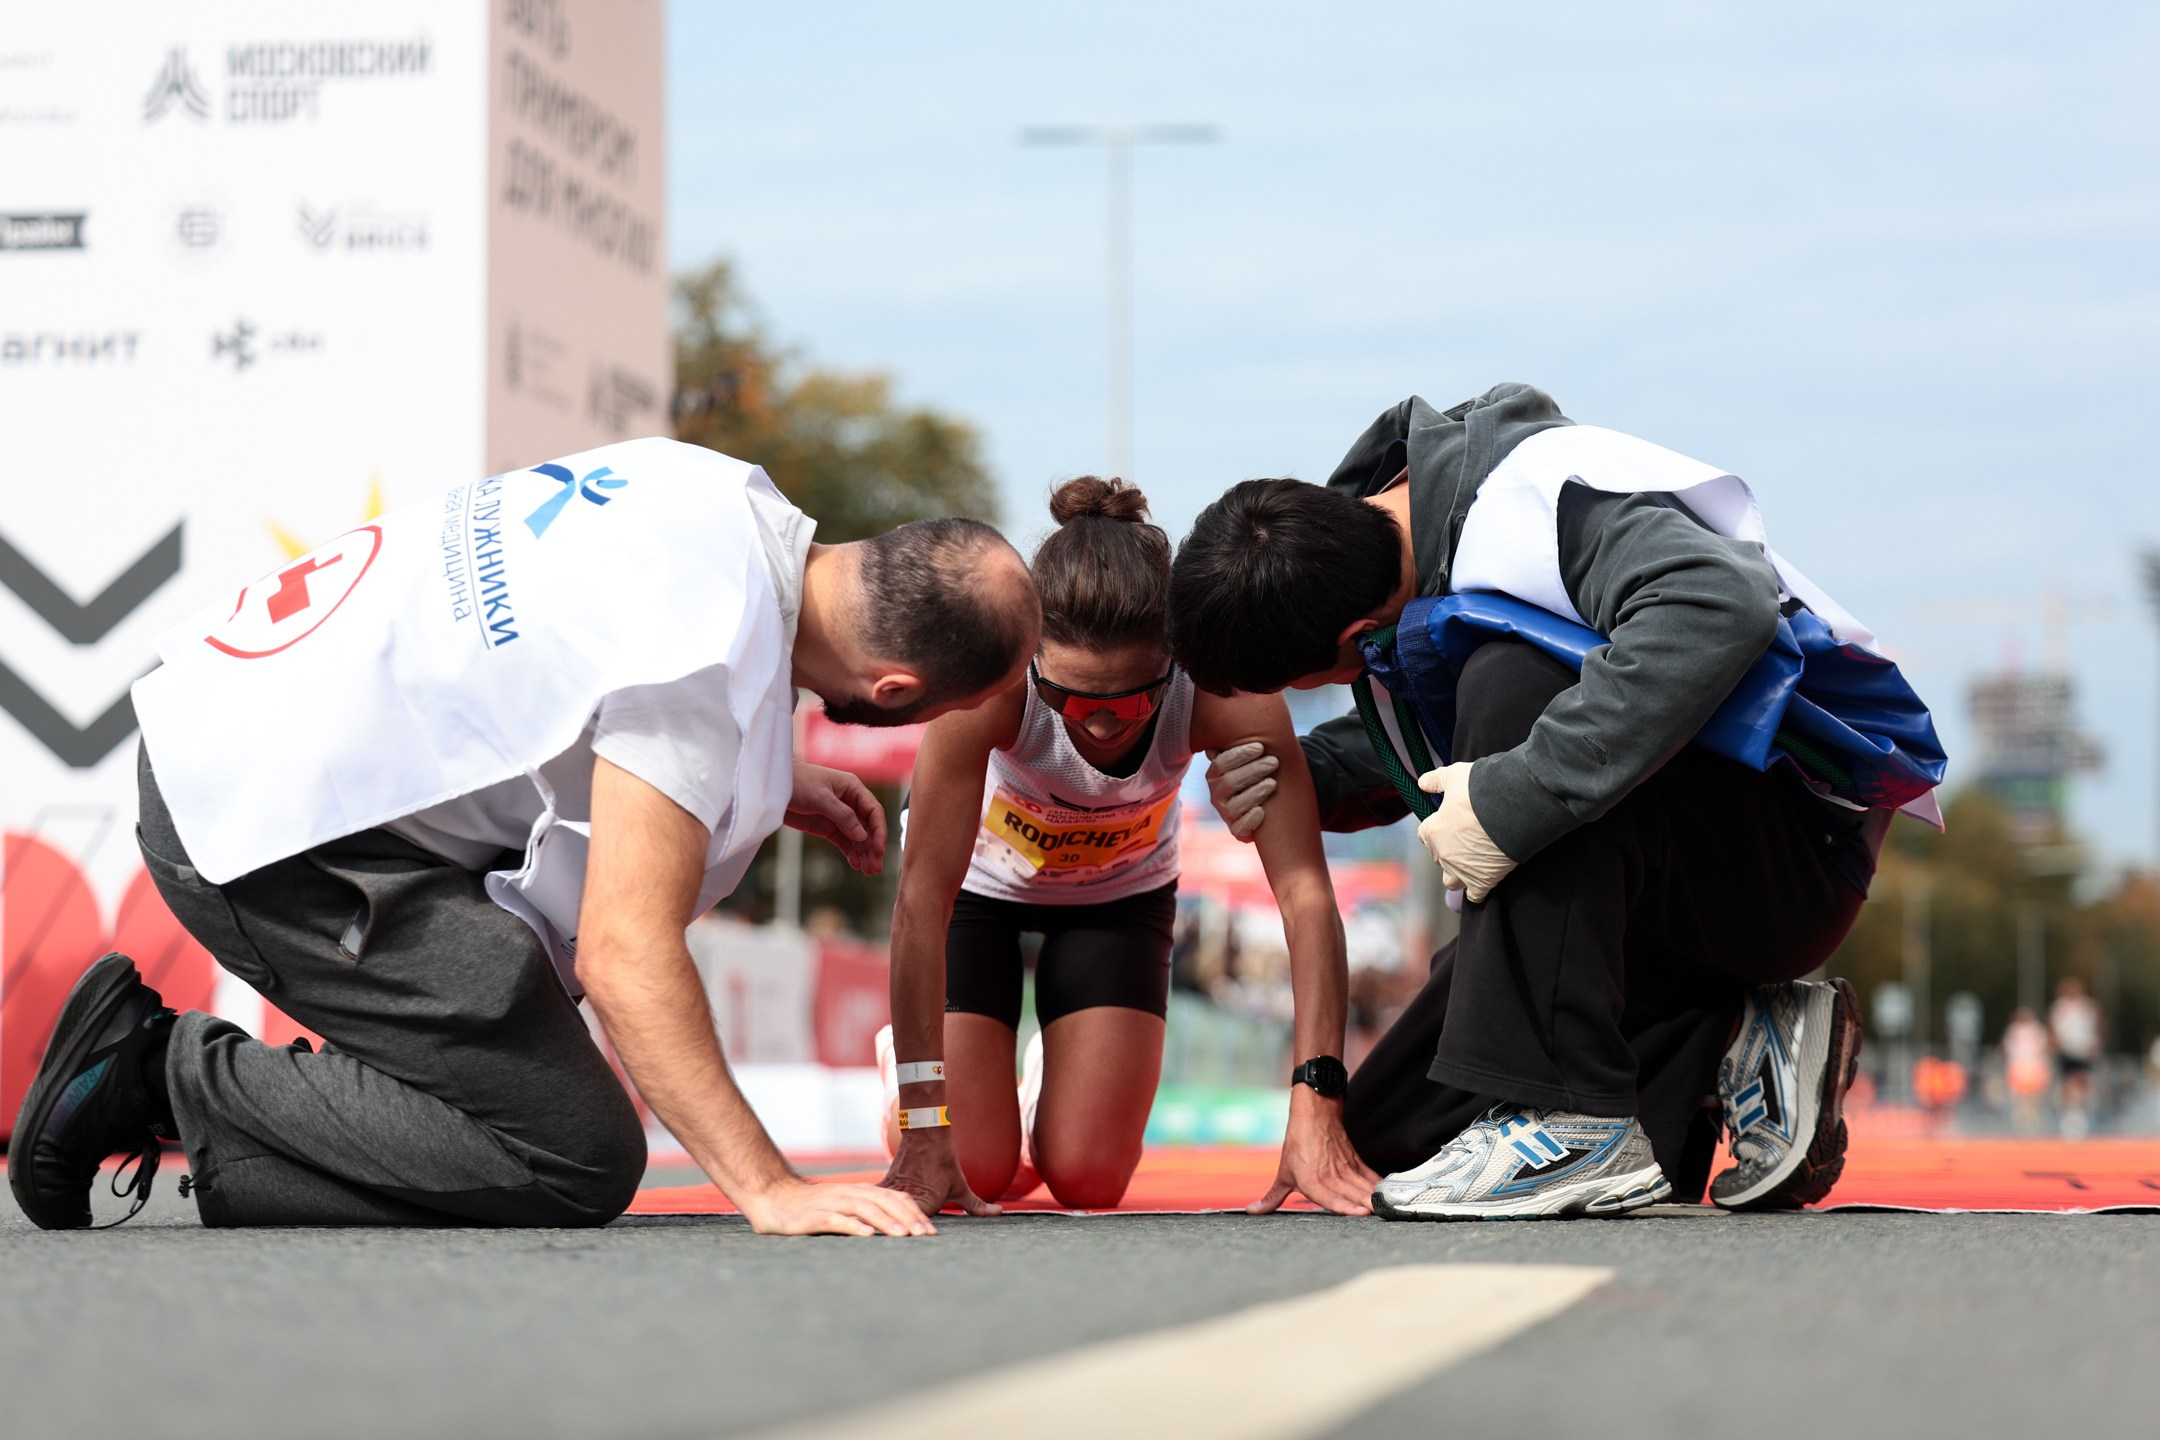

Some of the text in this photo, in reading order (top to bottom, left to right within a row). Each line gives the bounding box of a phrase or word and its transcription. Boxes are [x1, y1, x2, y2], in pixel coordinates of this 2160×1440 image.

[226, 28, 435, 78] МОСКОВСКИЙ
[227, 82, 322, 123] СПОРТ
[473, 500, 520, 647] ЛУЖНИКИ
[1003, 810, 1152, 852] RODICHEVA
[1058, 853, 1080, 863] 30
